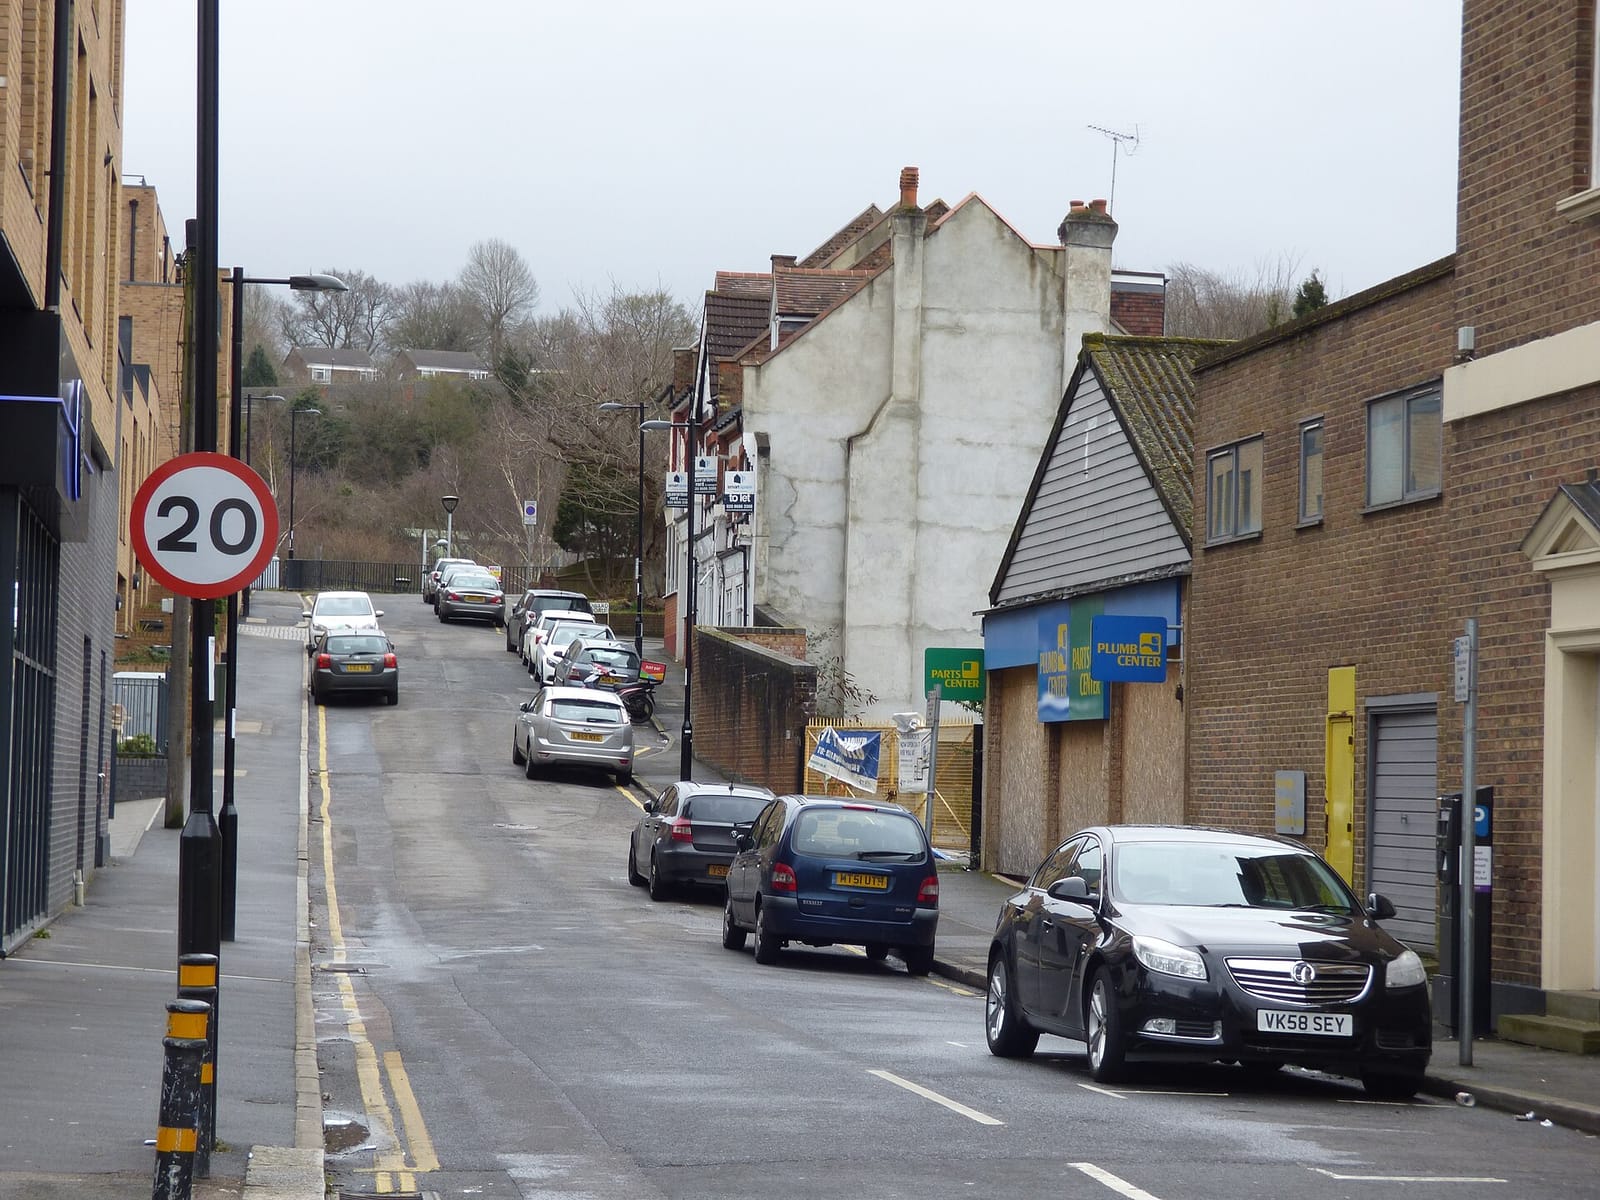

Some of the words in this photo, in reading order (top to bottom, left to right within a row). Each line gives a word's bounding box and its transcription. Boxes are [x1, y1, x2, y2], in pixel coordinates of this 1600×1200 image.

[729, 494, 738, 502] to
[740, 494, 751, 502] let
[157, 496, 257, 556] 20
[1097, 642, 1138, 655] PLUMB
[1040, 651, 1058, 674] PLUMB
[1072, 646, 1091, 670] PARTS
[1117, 655, 1161, 667] CENTER
[931, 669, 961, 679] PARTS
[944, 678, 980, 688] CENTER
[1048, 675, 1067, 697] CENTER
[1265, 1012, 1308, 1030] VK58
[1313, 1016, 1344, 1033] SEY
